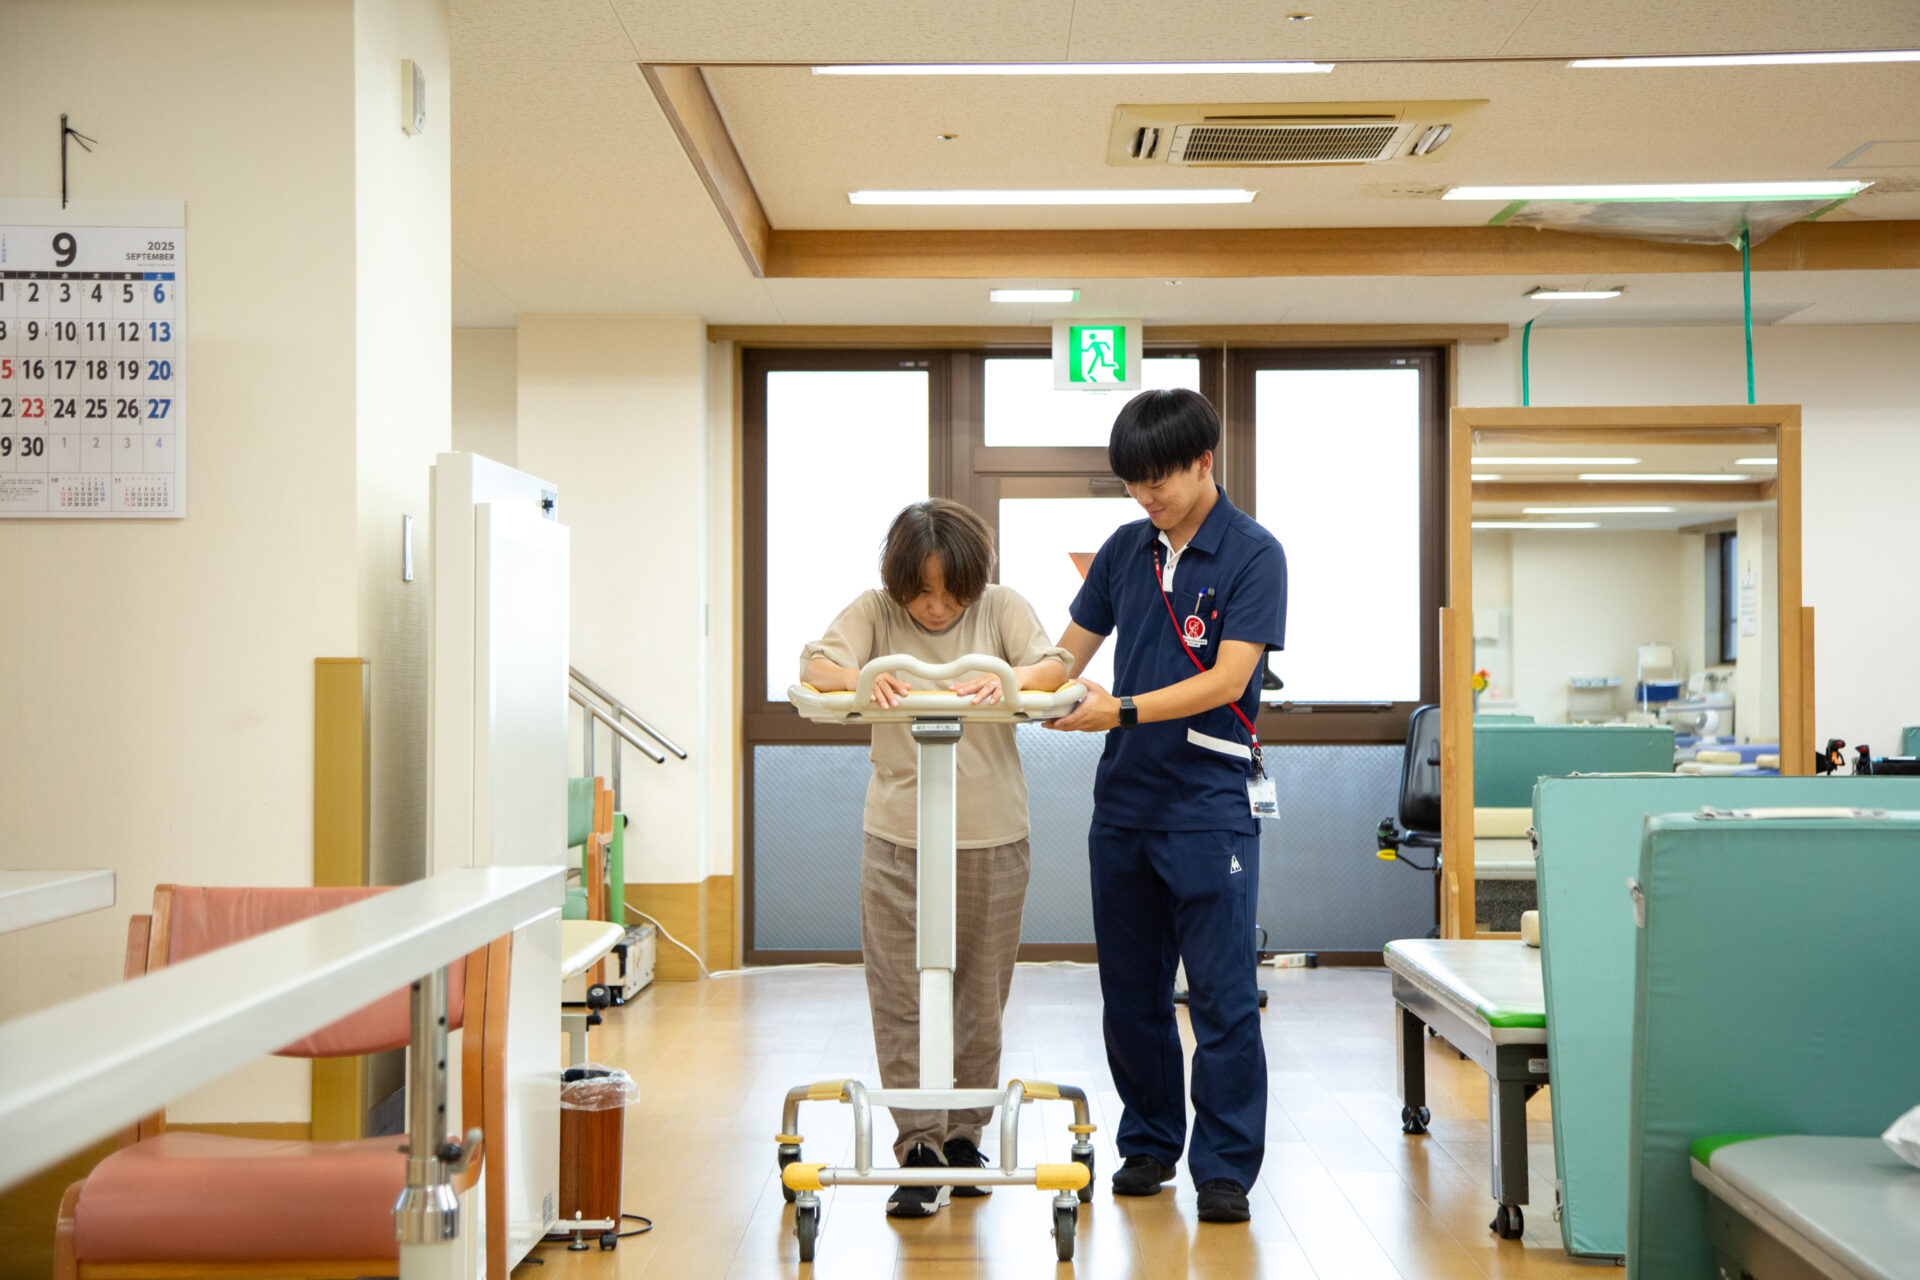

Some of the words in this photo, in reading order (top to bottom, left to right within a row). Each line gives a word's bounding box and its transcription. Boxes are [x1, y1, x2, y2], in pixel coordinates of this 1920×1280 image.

[52, 232, 77, 267] 9
[147, 241, 174, 251] 2025
[28, 282, 39, 302] 2
[60, 283, 71, 303] 3
[91, 283, 102, 303] 4
[123, 283, 134, 303] 5
[153, 283, 165, 304] 6
[27, 321, 39, 341] 9
[55, 321, 76, 341] 10
[87, 321, 105, 342] 11
[118, 322, 139, 342] 12
[149, 322, 171, 342] 13
[22, 359, 44, 380] 16
[54, 359, 76, 380] 17
[86, 360, 108, 380] 18
[117, 360, 139, 380] 19
[148, 360, 171, 381] 20
[21, 398, 44, 418] 23
[53, 398, 76, 418] 24
[85, 399, 108, 419] 25
[116, 399, 139, 419] 26
[147, 399, 171, 419] 27
[21, 436, 44, 457] 30
[62, 437, 66, 448] 1
[93, 437, 99, 448] 2
[124, 437, 131, 448] 3
[156, 437, 162, 449] 4
